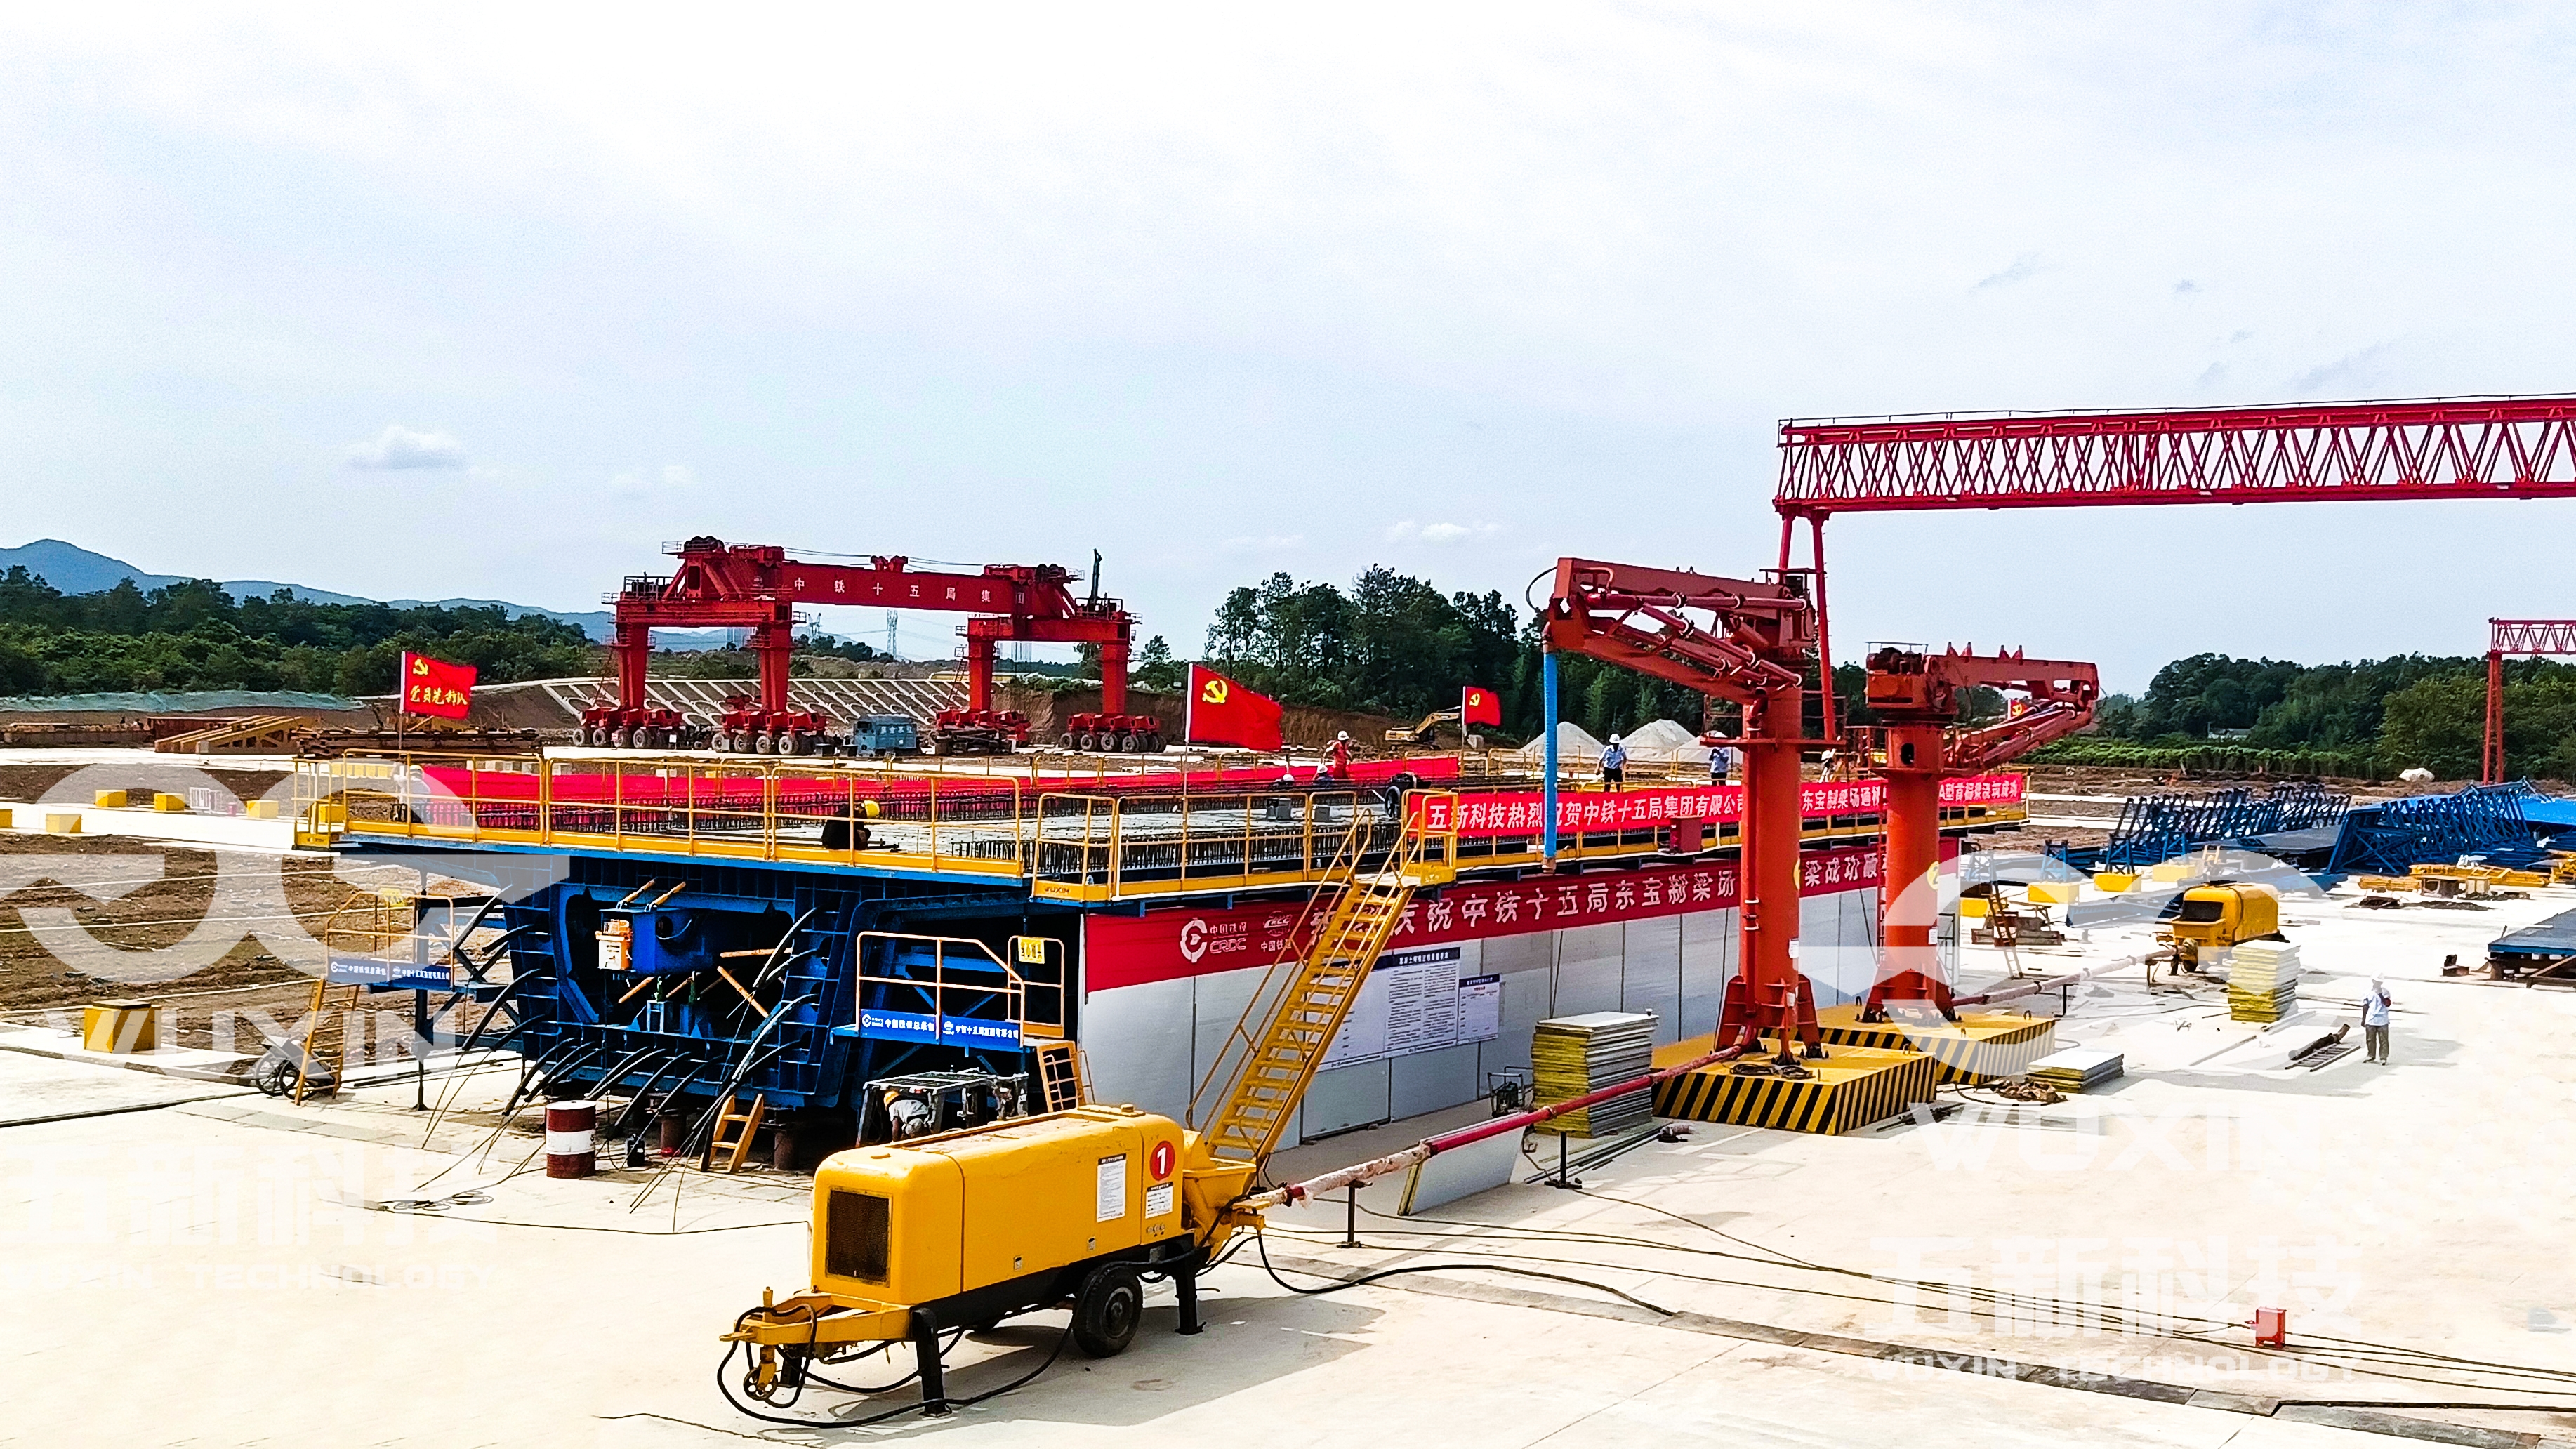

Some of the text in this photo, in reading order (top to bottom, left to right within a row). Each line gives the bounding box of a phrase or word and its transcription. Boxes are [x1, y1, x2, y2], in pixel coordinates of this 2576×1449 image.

[1310, 870, 1736, 945] 庆祝中铁十五局东宝制梁场
[1157, 1146, 1167, 1175] 1
